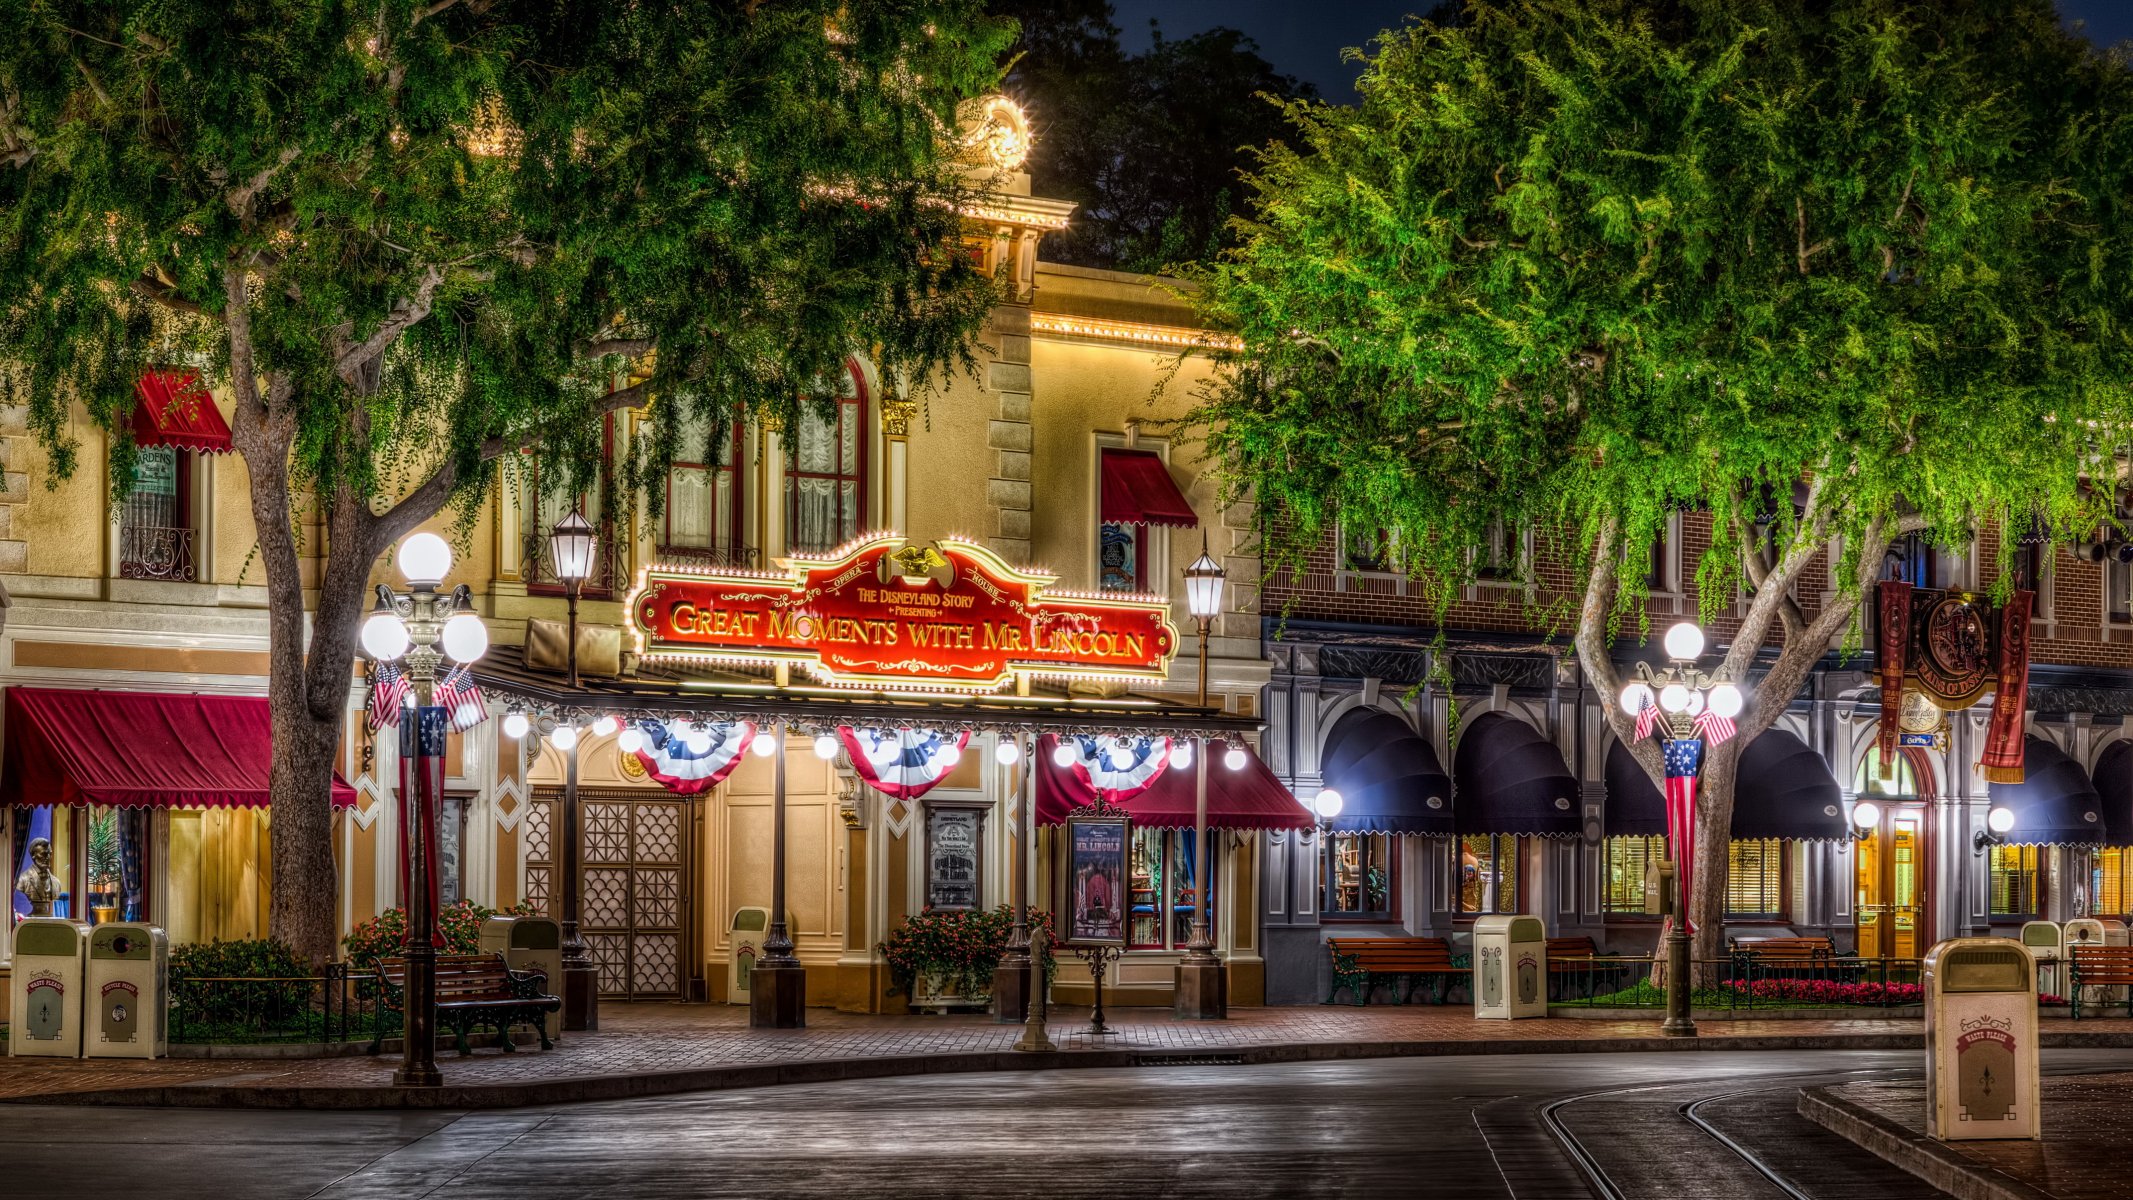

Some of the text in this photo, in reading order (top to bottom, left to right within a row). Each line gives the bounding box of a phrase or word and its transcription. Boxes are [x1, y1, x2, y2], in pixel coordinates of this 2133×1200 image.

[136, 452, 172, 465] ARDENS
[834, 566, 862, 587] OPERA
[971, 574, 999, 597] HOUSE
[857, 587, 975, 608] THE DISNEYLAND STORY
[895, 605, 936, 618] PRESENTING
[670, 602, 1145, 658] GREAT MOMENTS WITH MR. LINCOLN
[1964, 1031, 2008, 1042] WASTE PLEASE
